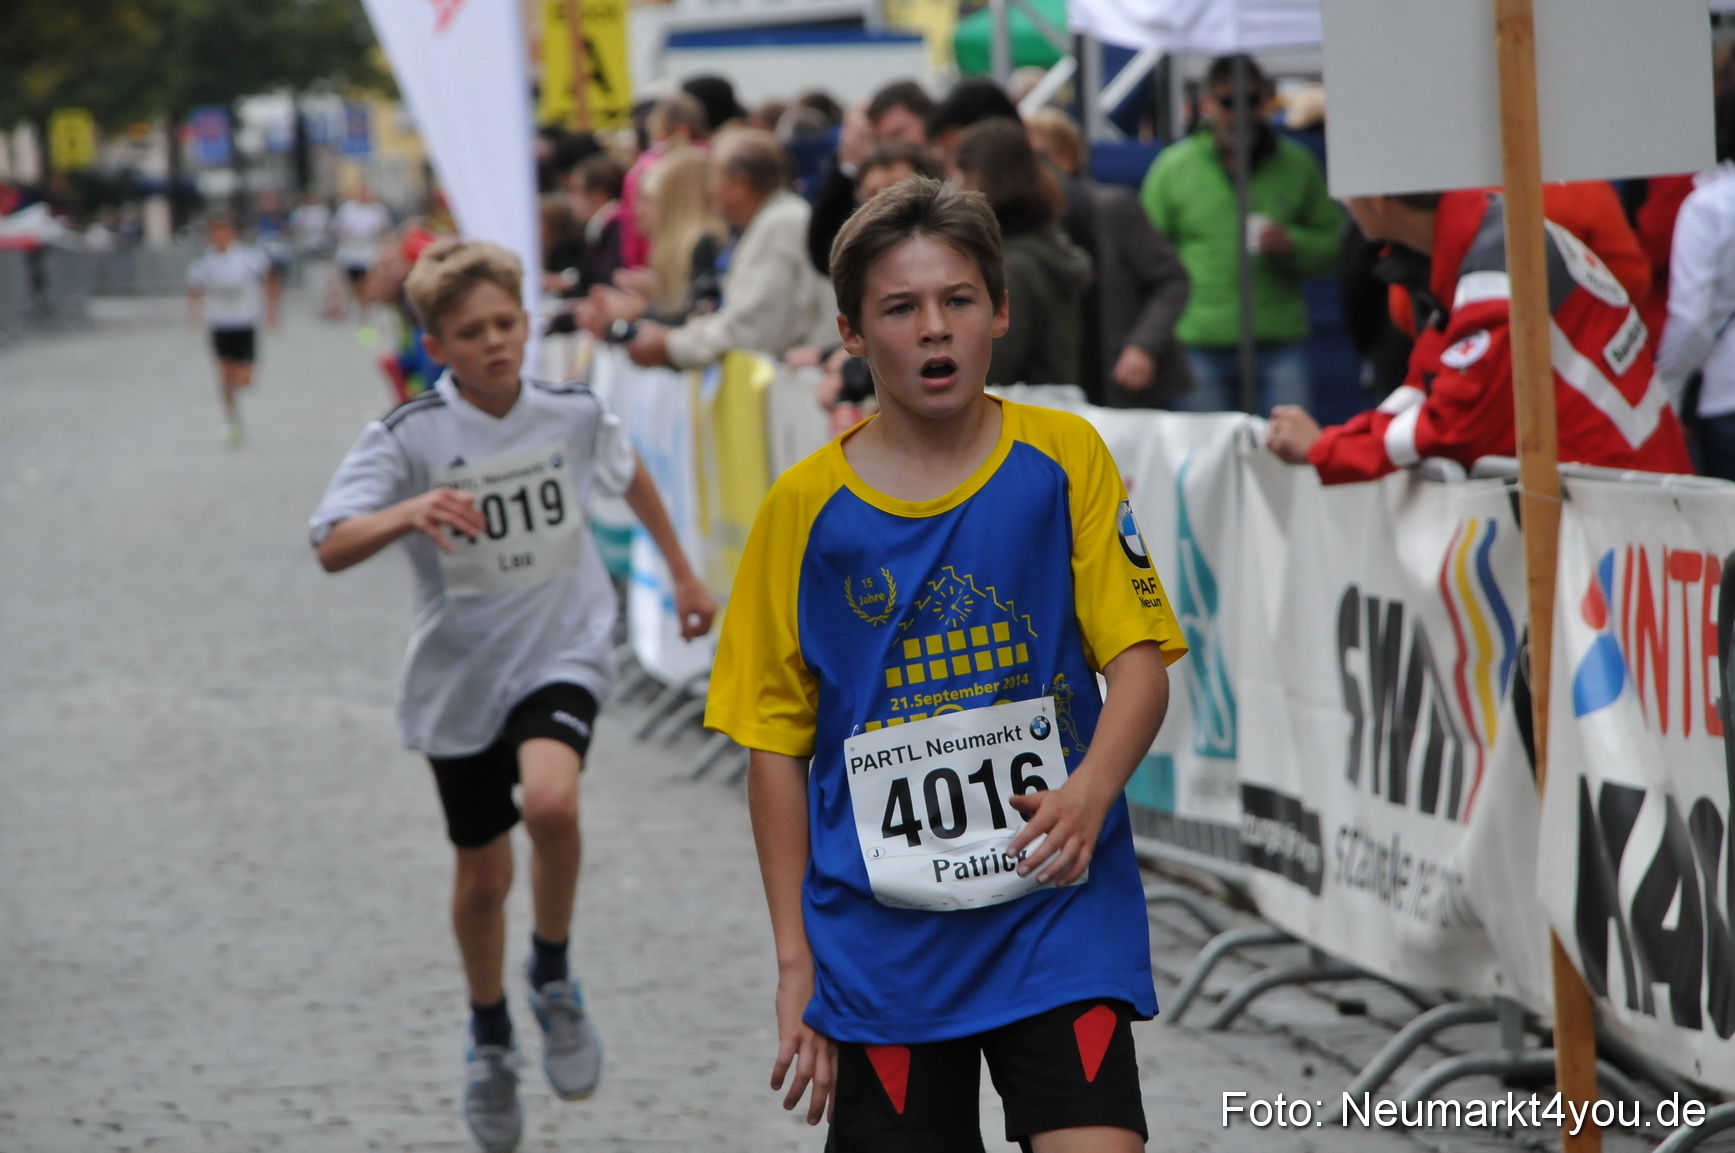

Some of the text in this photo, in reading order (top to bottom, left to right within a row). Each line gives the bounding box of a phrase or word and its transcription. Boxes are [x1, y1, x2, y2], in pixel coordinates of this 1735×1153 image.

[451, 478, 565, 546] 019
[859, 591, 886, 606] Jahre
[862, 577, 873, 589] 15
[1621, 542, 1729, 740] INTE
[890, 673, 1030, 711] 21.September 2014
[850, 725, 1023, 775] PARTL Neumarkt
[881, 752, 1049, 848] 4016
